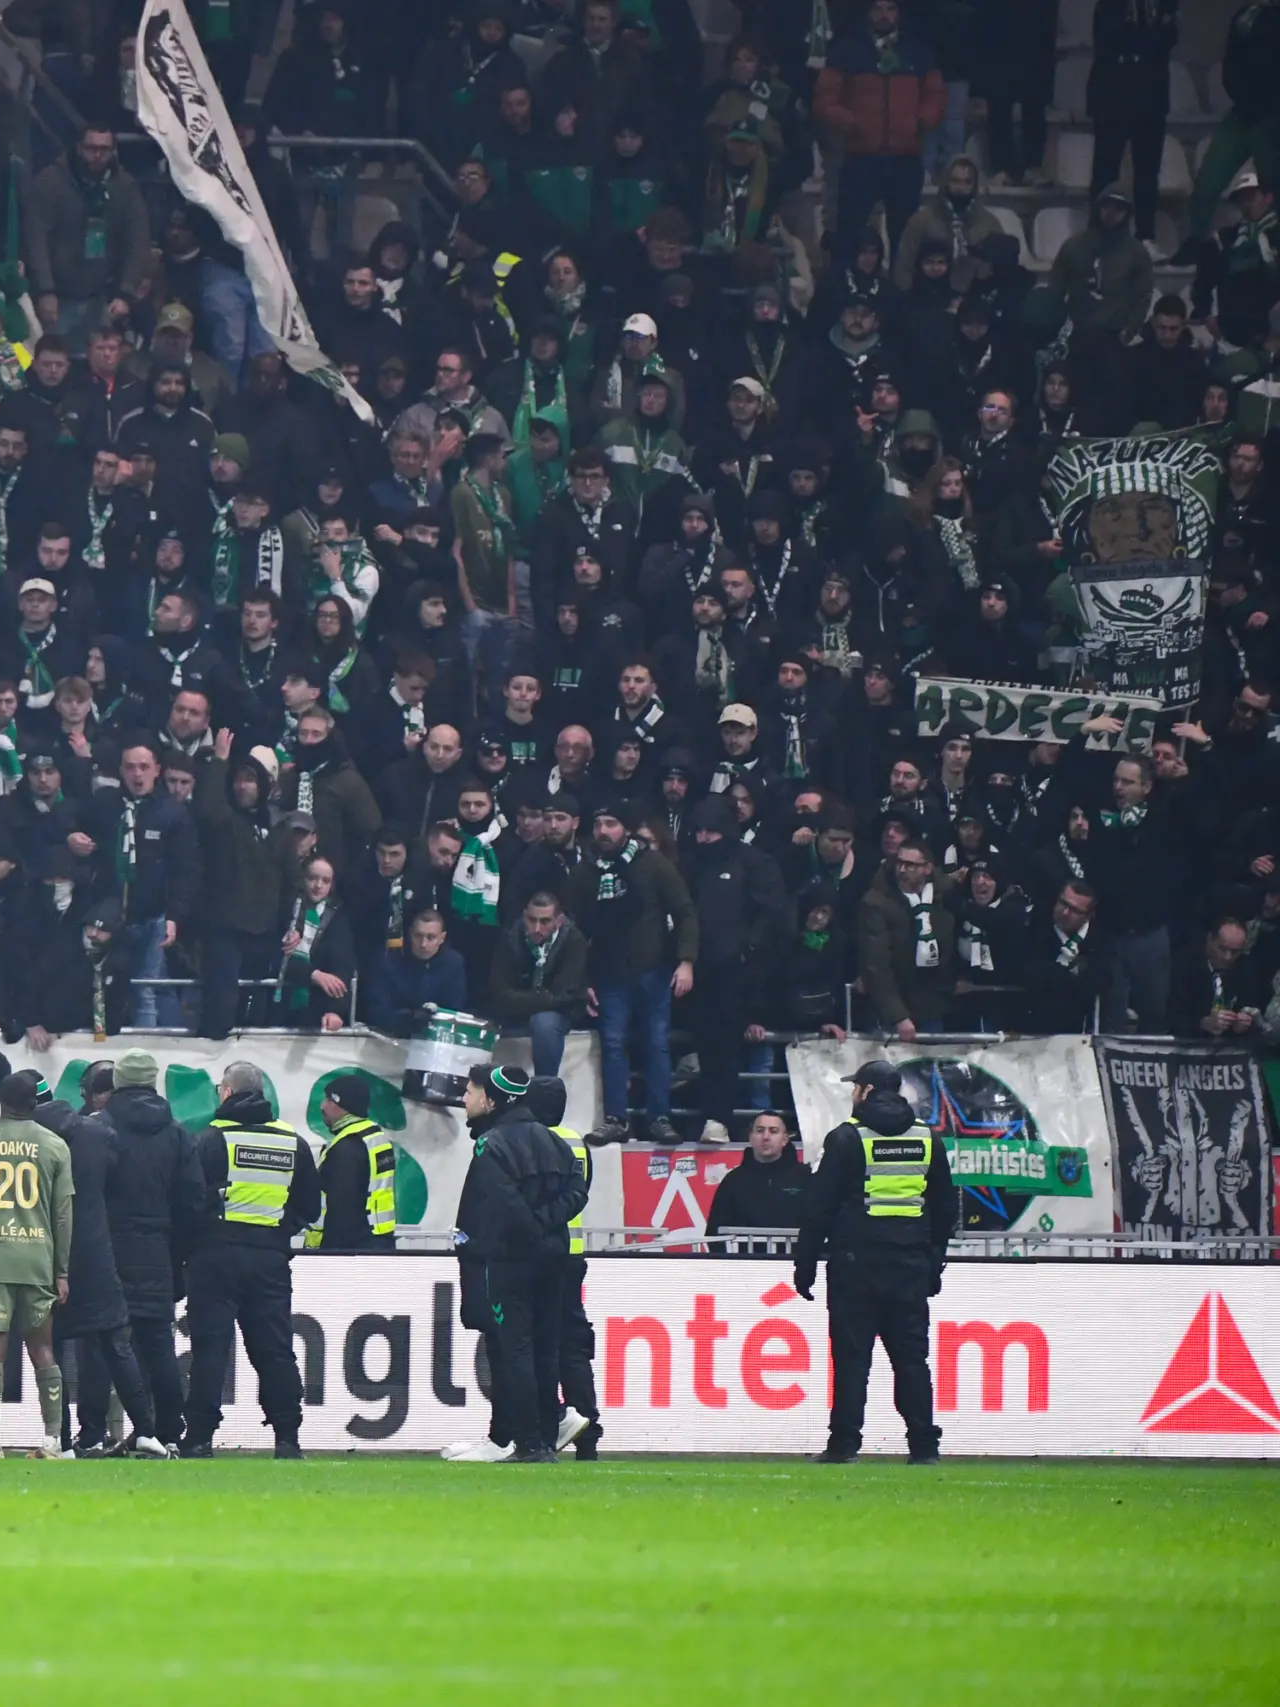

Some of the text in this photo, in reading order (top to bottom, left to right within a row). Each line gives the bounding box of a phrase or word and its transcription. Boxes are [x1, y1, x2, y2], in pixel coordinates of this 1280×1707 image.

[1047, 438, 1220, 500] MAZURIAT
[917, 685, 1160, 753] ARDECHE
[1110, 1059, 1246, 1091] GREEN ANGELS
[947, 1144, 1046, 1180] dantistes
[558, 1281, 1050, 1410] ntém
